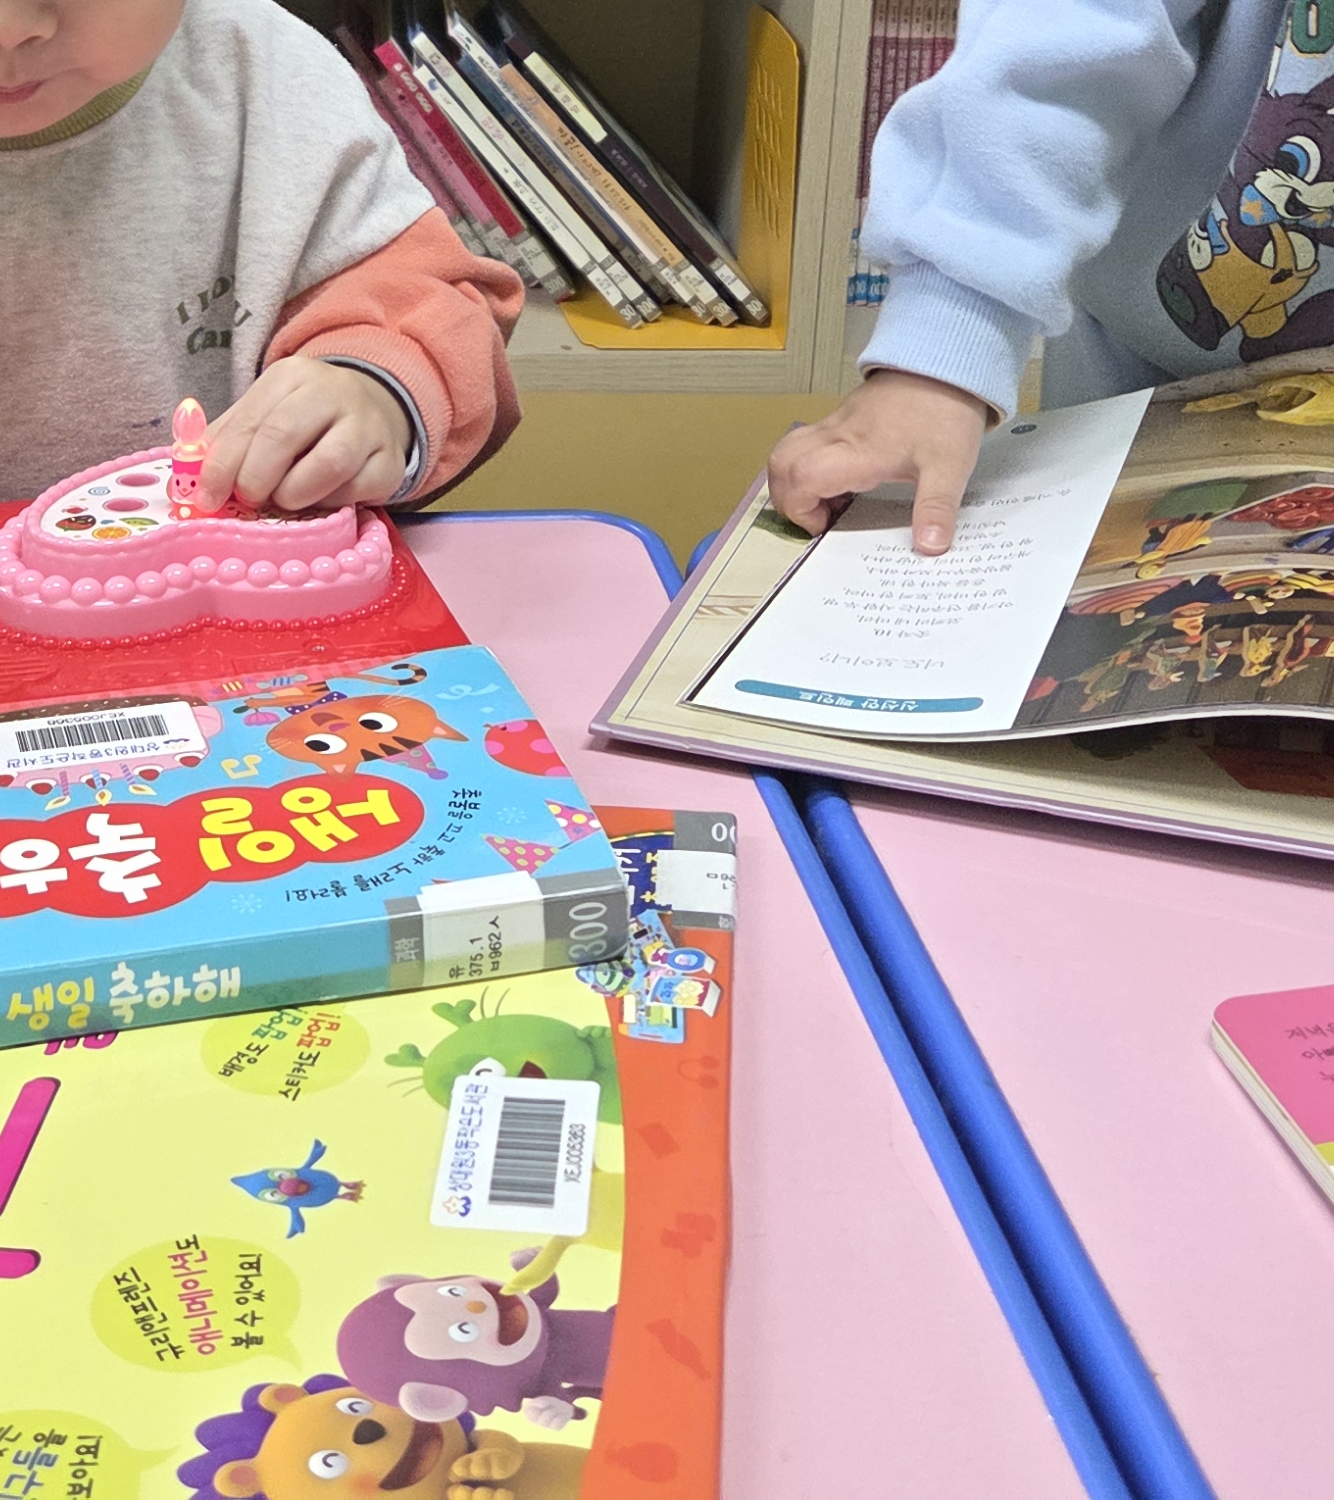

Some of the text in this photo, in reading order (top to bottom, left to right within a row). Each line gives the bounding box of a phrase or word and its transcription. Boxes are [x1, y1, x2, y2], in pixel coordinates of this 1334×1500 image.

[797, 690, 919, 712] 신선한 페인트
[5, 739, 184, 770] 상대원3동작은도서관
[195, 777, 403, 873] 생일
[436, 822, 466, 845] 끄고
[283, 875, 346, 907] 불러요!
[350, 857, 414, 895] 노래를
[468, 934, 485, 978] 375.1
[489, 914, 505, 973] ㅂ962ㅅ
[567, 900, 609, 964] 300
[6, 959, 242, 1032] 생일 축하해
[449, 964, 466, 979] 유
[217, 1042, 270, 1078] 배경도
[278, 1011, 341, 1103] 스티커도 팝업!
[113, 1265, 186, 1362] 규리앤프렌즈
[167, 1233, 225, 1356] 애니메이션도
[231, 1252, 265, 1350] 볼 수 있어요!
